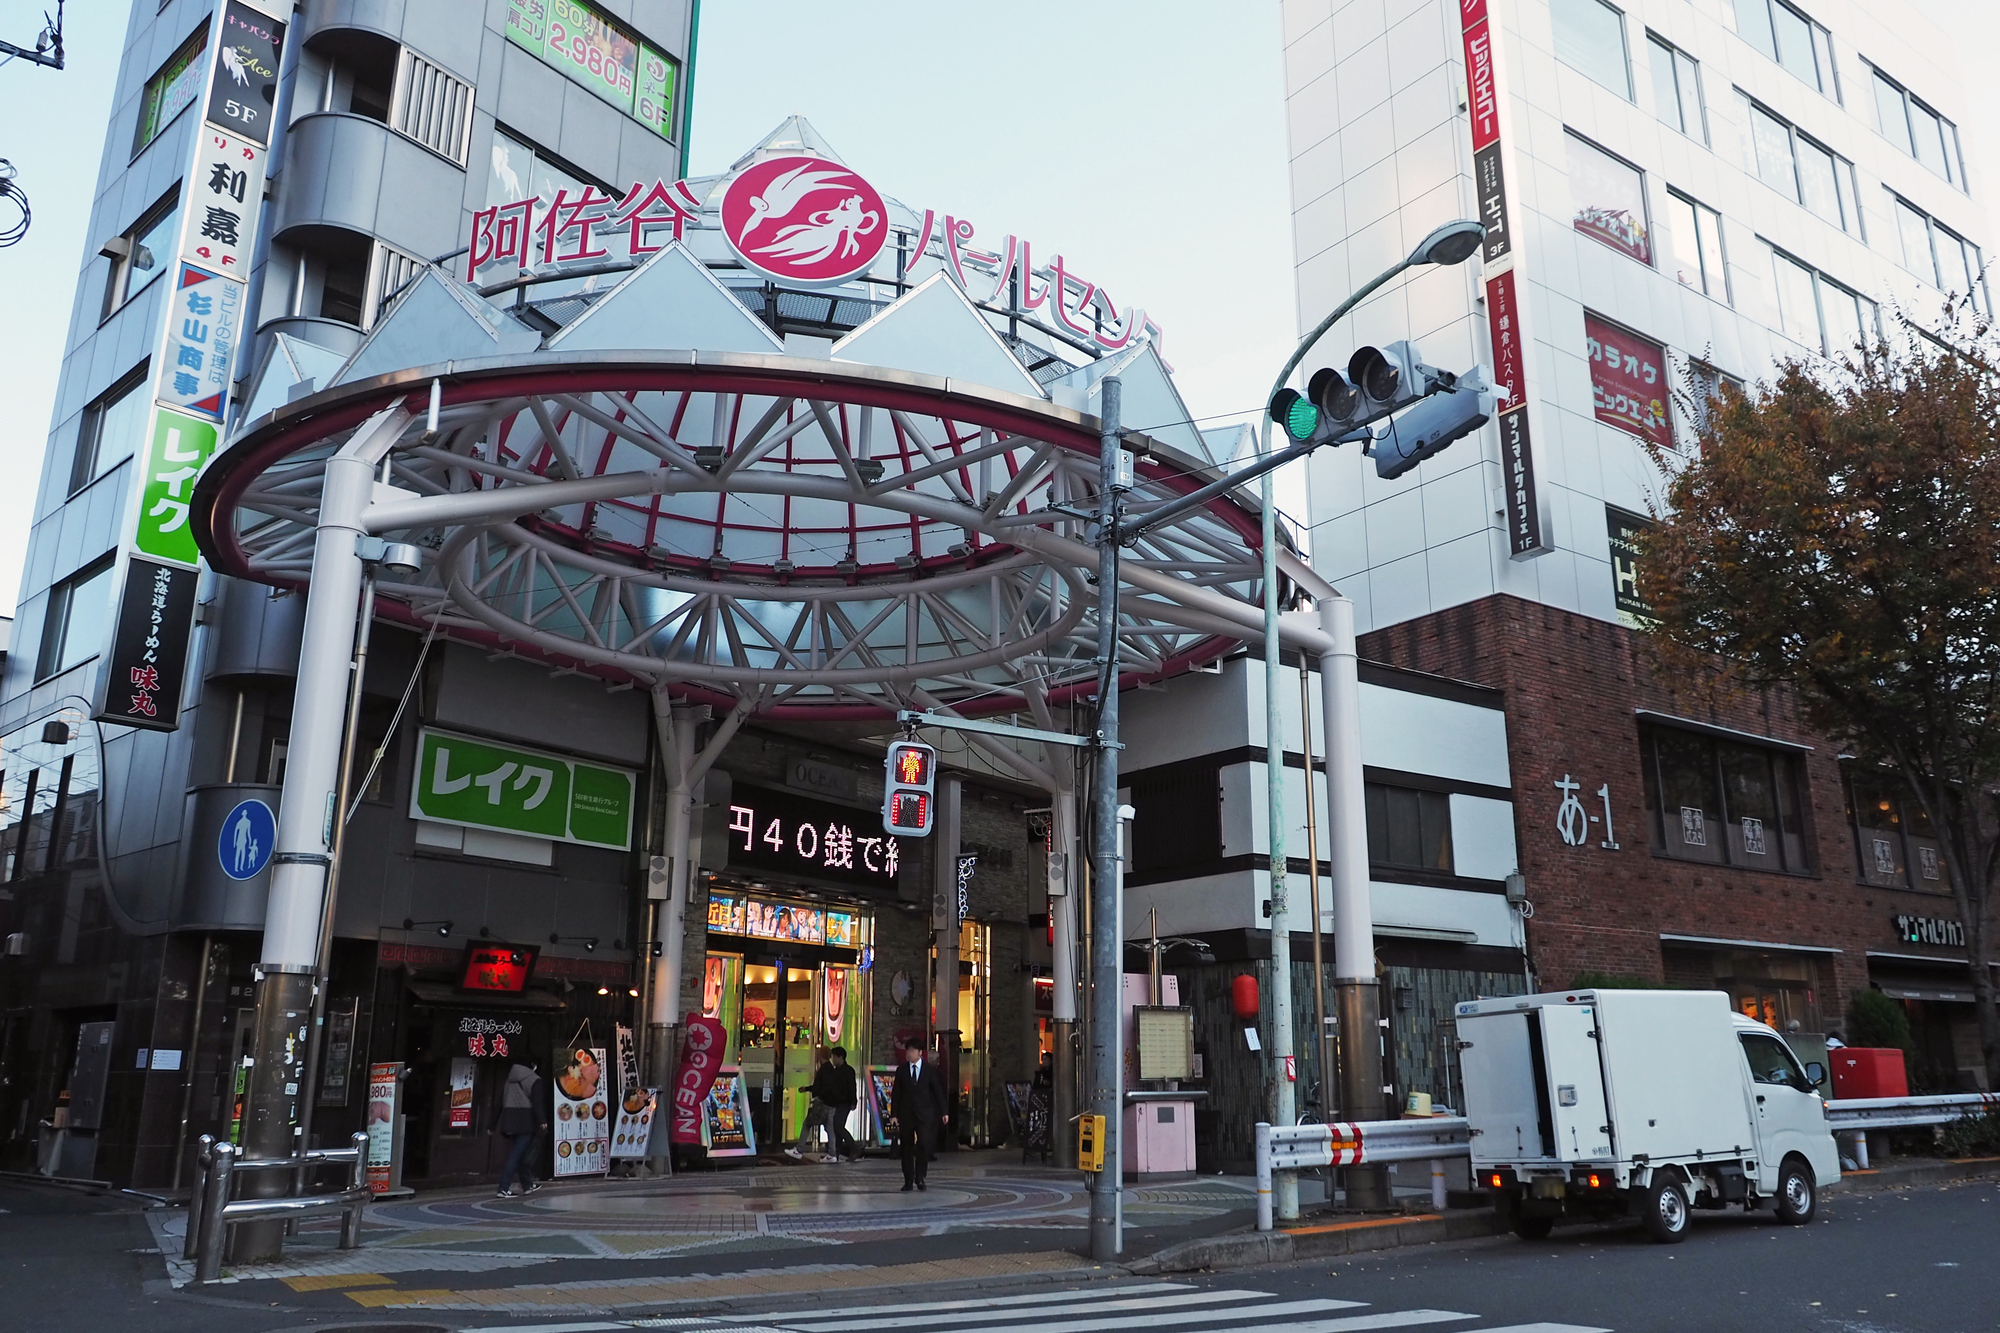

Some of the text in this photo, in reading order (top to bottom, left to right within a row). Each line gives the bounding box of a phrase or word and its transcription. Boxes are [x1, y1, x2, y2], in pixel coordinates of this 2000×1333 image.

[228, 14, 280, 45] キャバクラ
[508, 7, 544, 40] 肩コリ
[553, 0, 596, 36] 60分
[235, 55, 273, 78] Ace
[549, 23, 631, 97] 2,980円
[642, 77, 670, 100] 楽一
[1470, 31, 1494, 135] ビッグエコー
[224, 99, 258, 123] 5F
[640, 96, 668, 126] 6F
[213, 136, 255, 161] りか
[200, 162, 247, 248] 利嘉
[467, 180, 701, 284] 阿佐谷
[1489, 241, 1505, 257] 3F
[196, 246, 236, 266] 4F
[173, 291, 213, 396] 杉山商事
[208, 283, 238, 385] 当ビルの管理は
[1498, 315, 1514, 392] 鎌倉パスタ
[1587, 336, 1657, 384] カラオケ
[1505, 394, 1519, 408] 2F
[149, 427, 200, 533] レイク
[1508, 414, 1529, 534] サンマルクカフェ
[1519, 536, 1533, 550] 1F
[142, 567, 172, 664] 北海道らーめん
[1618, 596, 1641, 609] HUMAN
[127, 665, 161, 717] 味丸
[432, 746, 554, 811] レイク
[467, 1032, 509, 1058] 味丸
[674, 1050, 708, 1134] OCEAN
